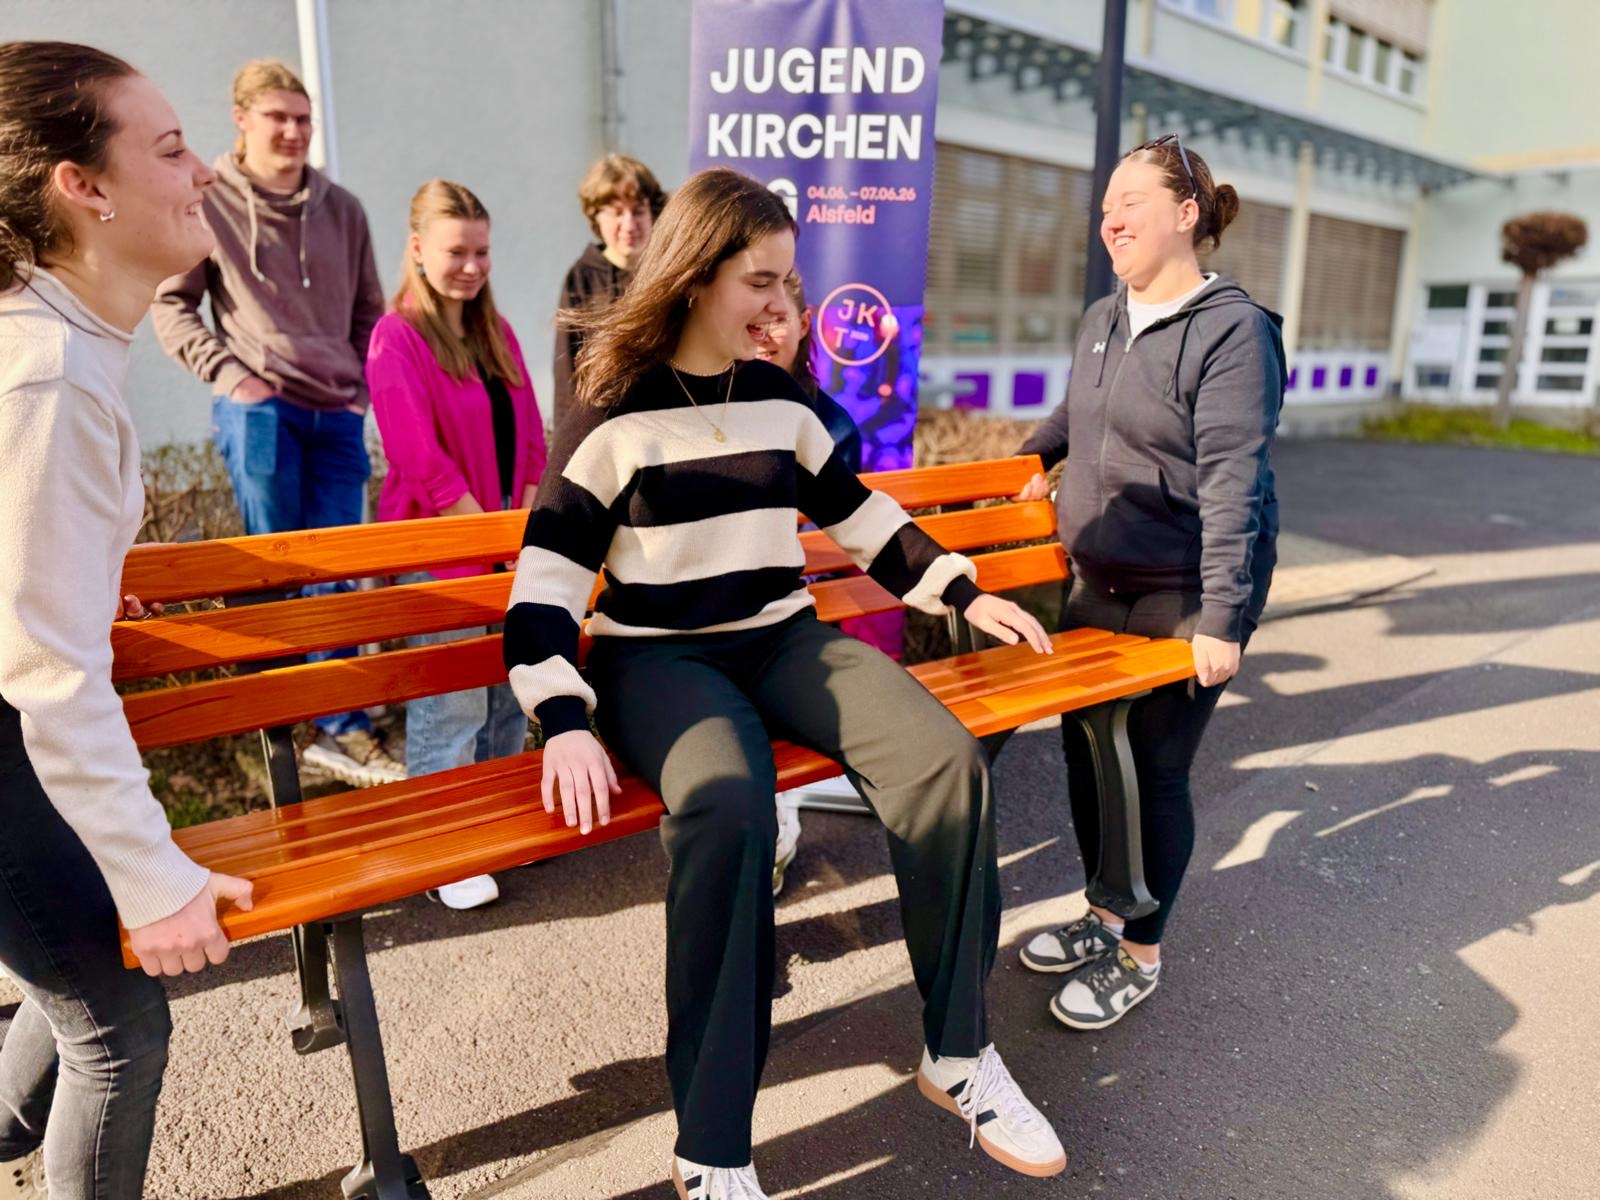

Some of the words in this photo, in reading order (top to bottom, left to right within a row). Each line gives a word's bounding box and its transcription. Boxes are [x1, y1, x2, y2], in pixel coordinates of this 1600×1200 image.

[710, 47, 925, 94] JUGEND
[708, 113, 922, 160] KIRCHEN
[860, 186, 916, 201] 07.06.26
[806, 204, 876, 224] Alsfeld
